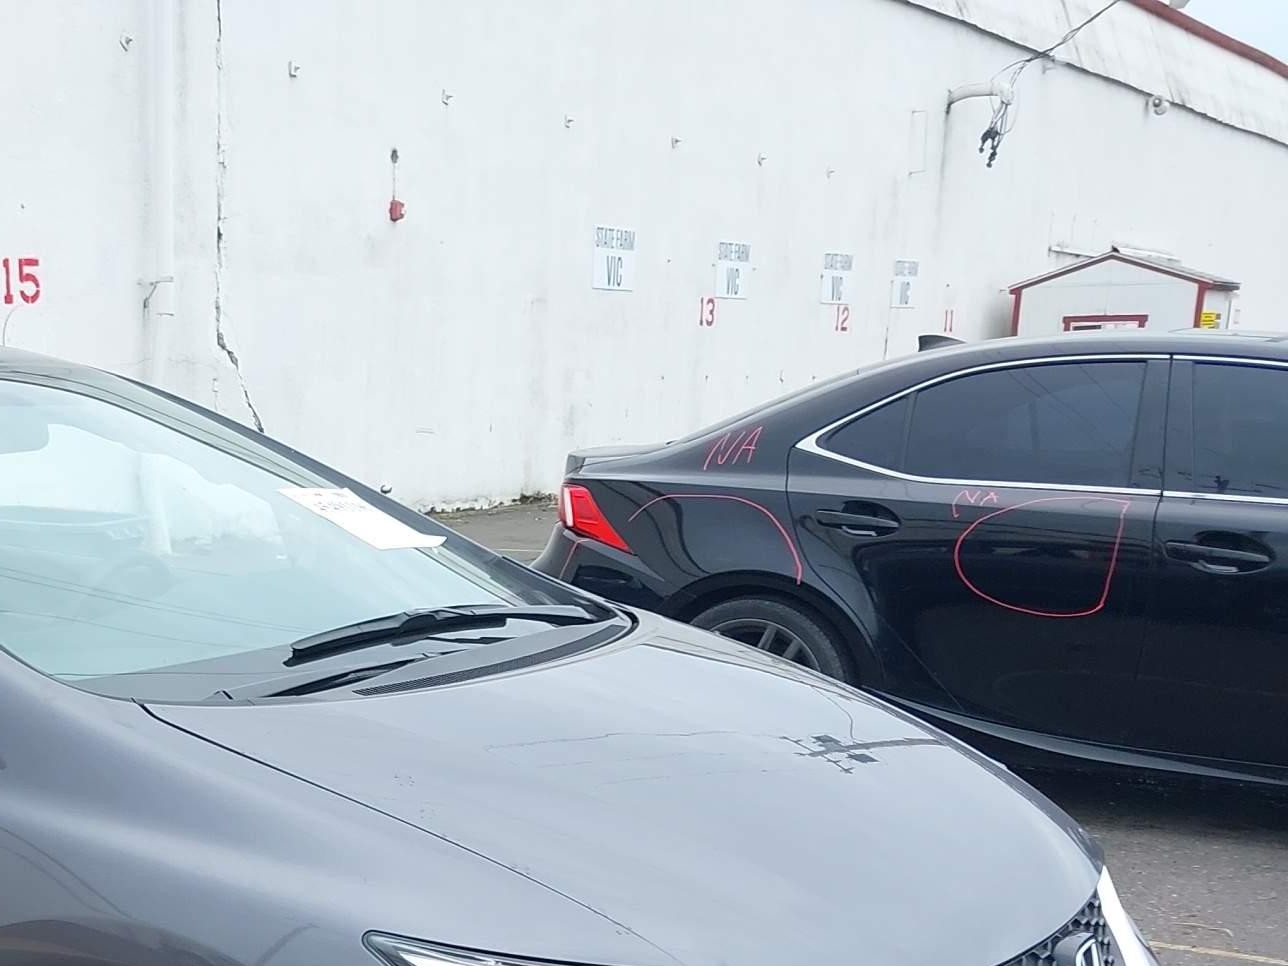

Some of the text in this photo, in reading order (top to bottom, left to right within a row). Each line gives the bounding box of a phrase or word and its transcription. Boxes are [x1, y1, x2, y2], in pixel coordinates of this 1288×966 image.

[596, 226, 635, 251] STATE FARM
[2, 257, 41, 305] 15
[606, 255, 623, 287] VIC
[726, 267, 740, 296] VIC
[699, 297, 716, 327] 13
[835, 305, 850, 332] 12
[943, 309, 954, 333] 11
[703, 426, 763, 471] NA
